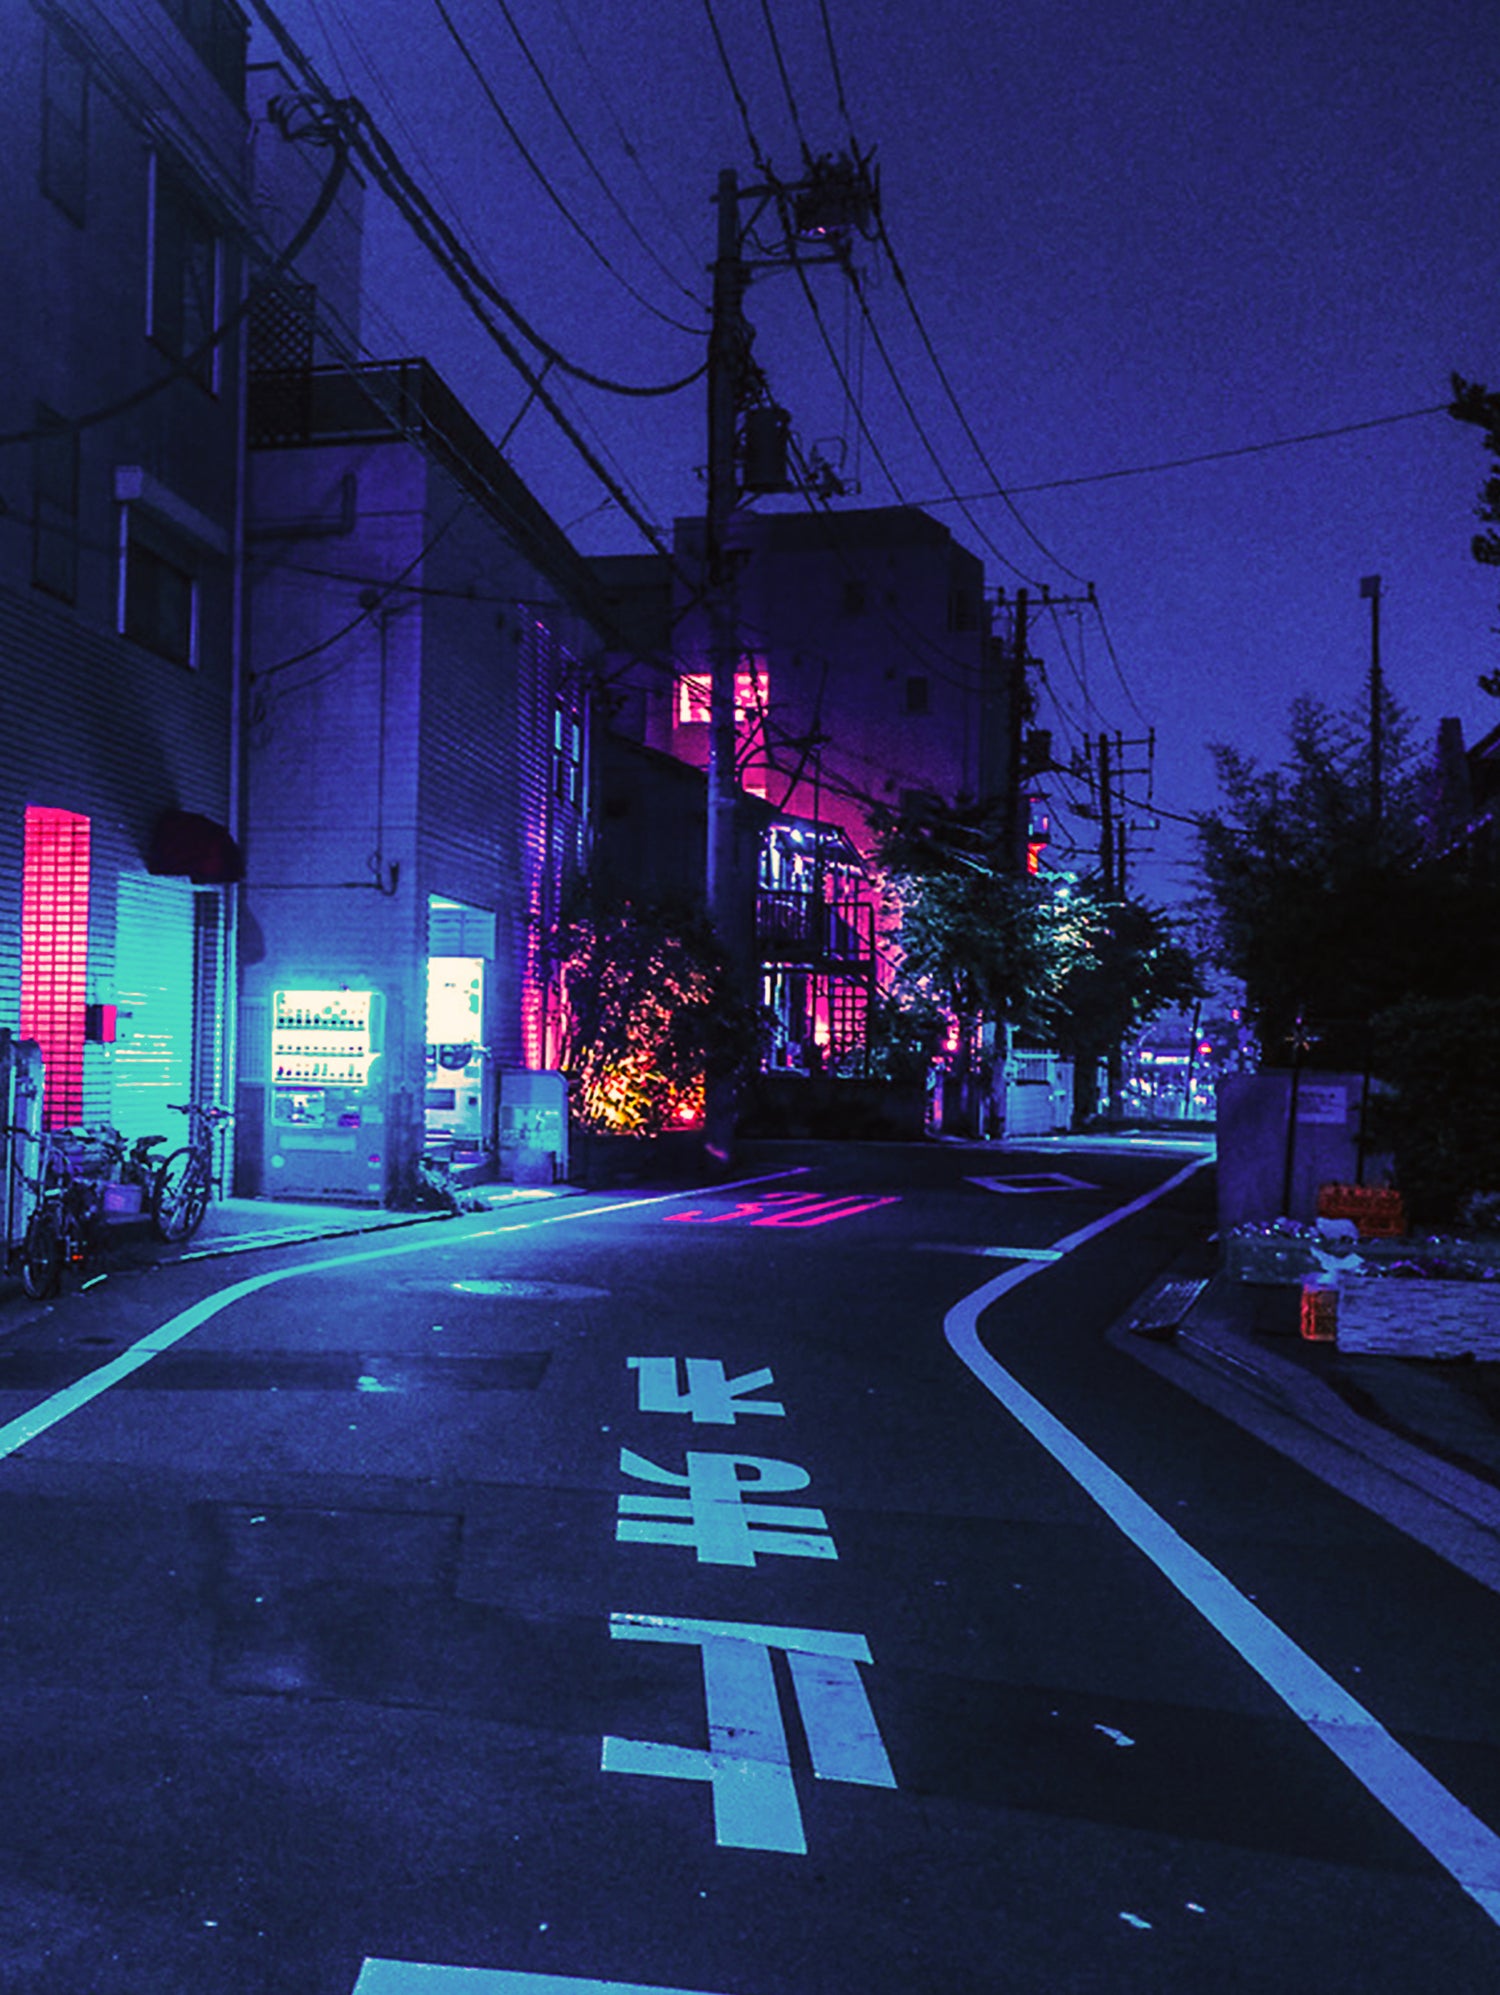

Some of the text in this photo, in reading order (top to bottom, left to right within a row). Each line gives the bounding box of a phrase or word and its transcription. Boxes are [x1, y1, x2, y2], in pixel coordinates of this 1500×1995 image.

[662, 1191, 901, 1228] 30
[600, 1356, 898, 1855] 止まれ
